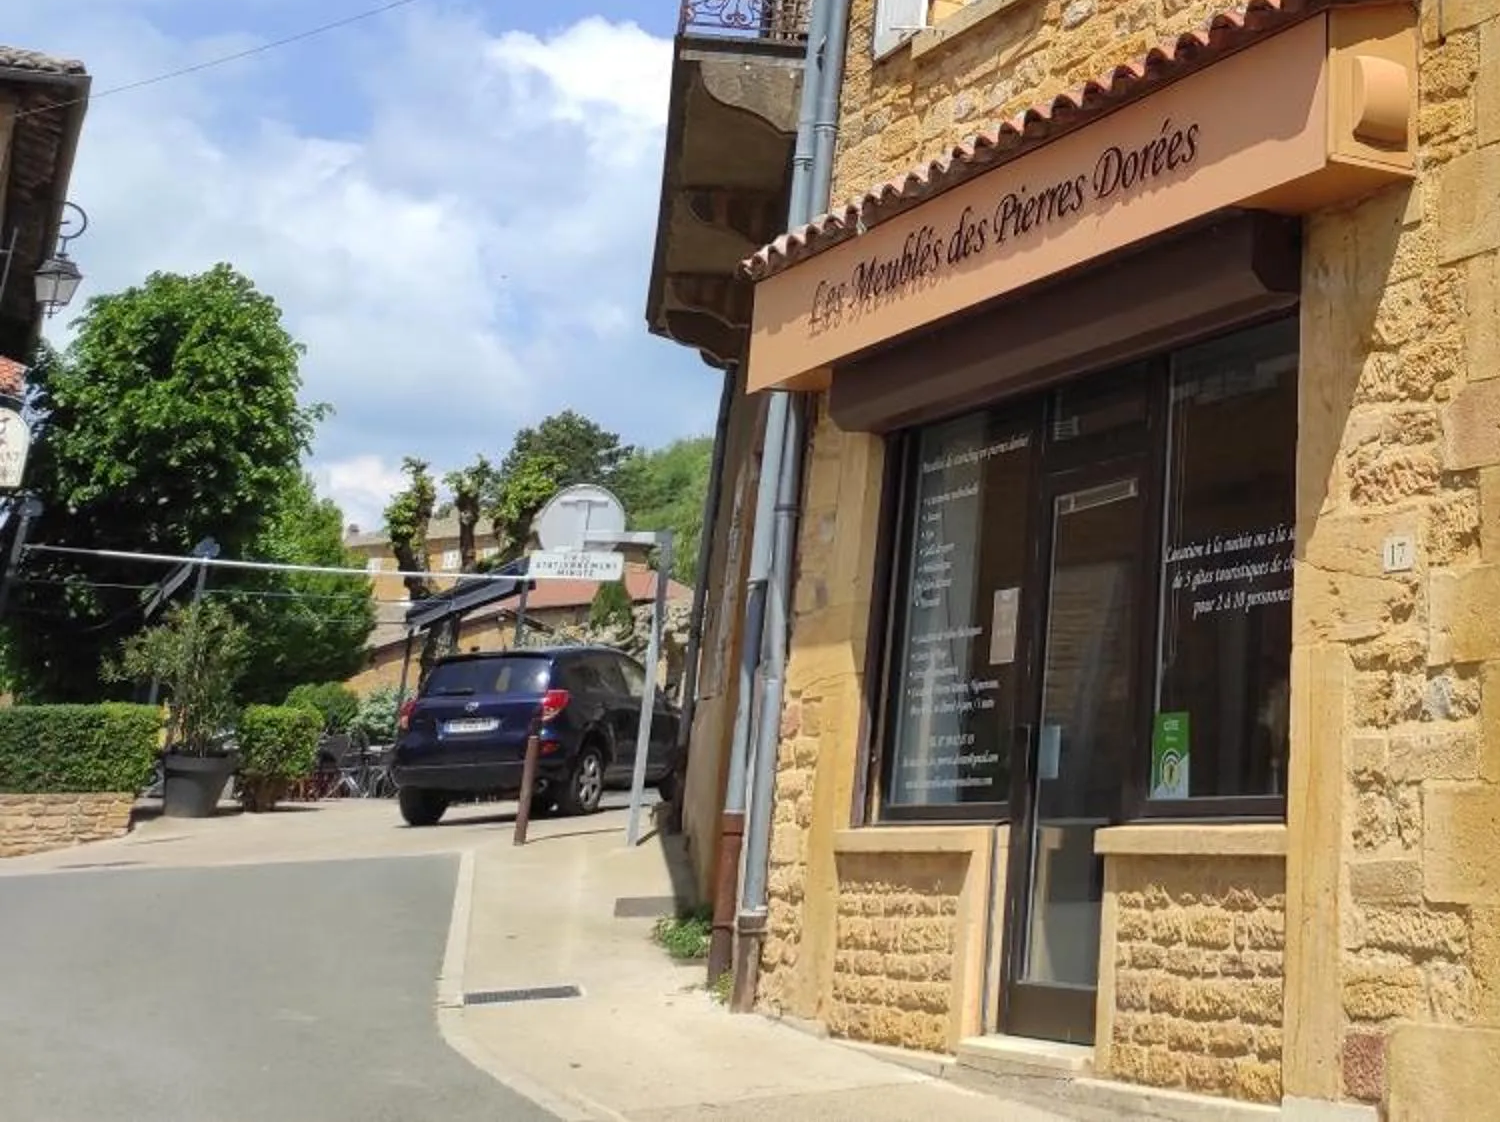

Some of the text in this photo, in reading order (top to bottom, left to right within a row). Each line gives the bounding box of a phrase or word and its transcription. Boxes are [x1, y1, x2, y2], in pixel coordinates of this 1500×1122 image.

[810, 118, 1200, 324] Les Meublés des Pierres Dorées
[1164, 541, 1205, 563] Location
[1213, 535, 1223, 554] la
[1254, 533, 1267, 547] ou
[1276, 523, 1287, 543] la
[1391, 542, 1406, 567] 17
[1172, 569, 1183, 589] de
[1215, 560, 1269, 584] touristiques
[1270, 553, 1283, 573] de
[1192, 598, 1215, 621] pour
[1216, 592, 1223, 611] 2
